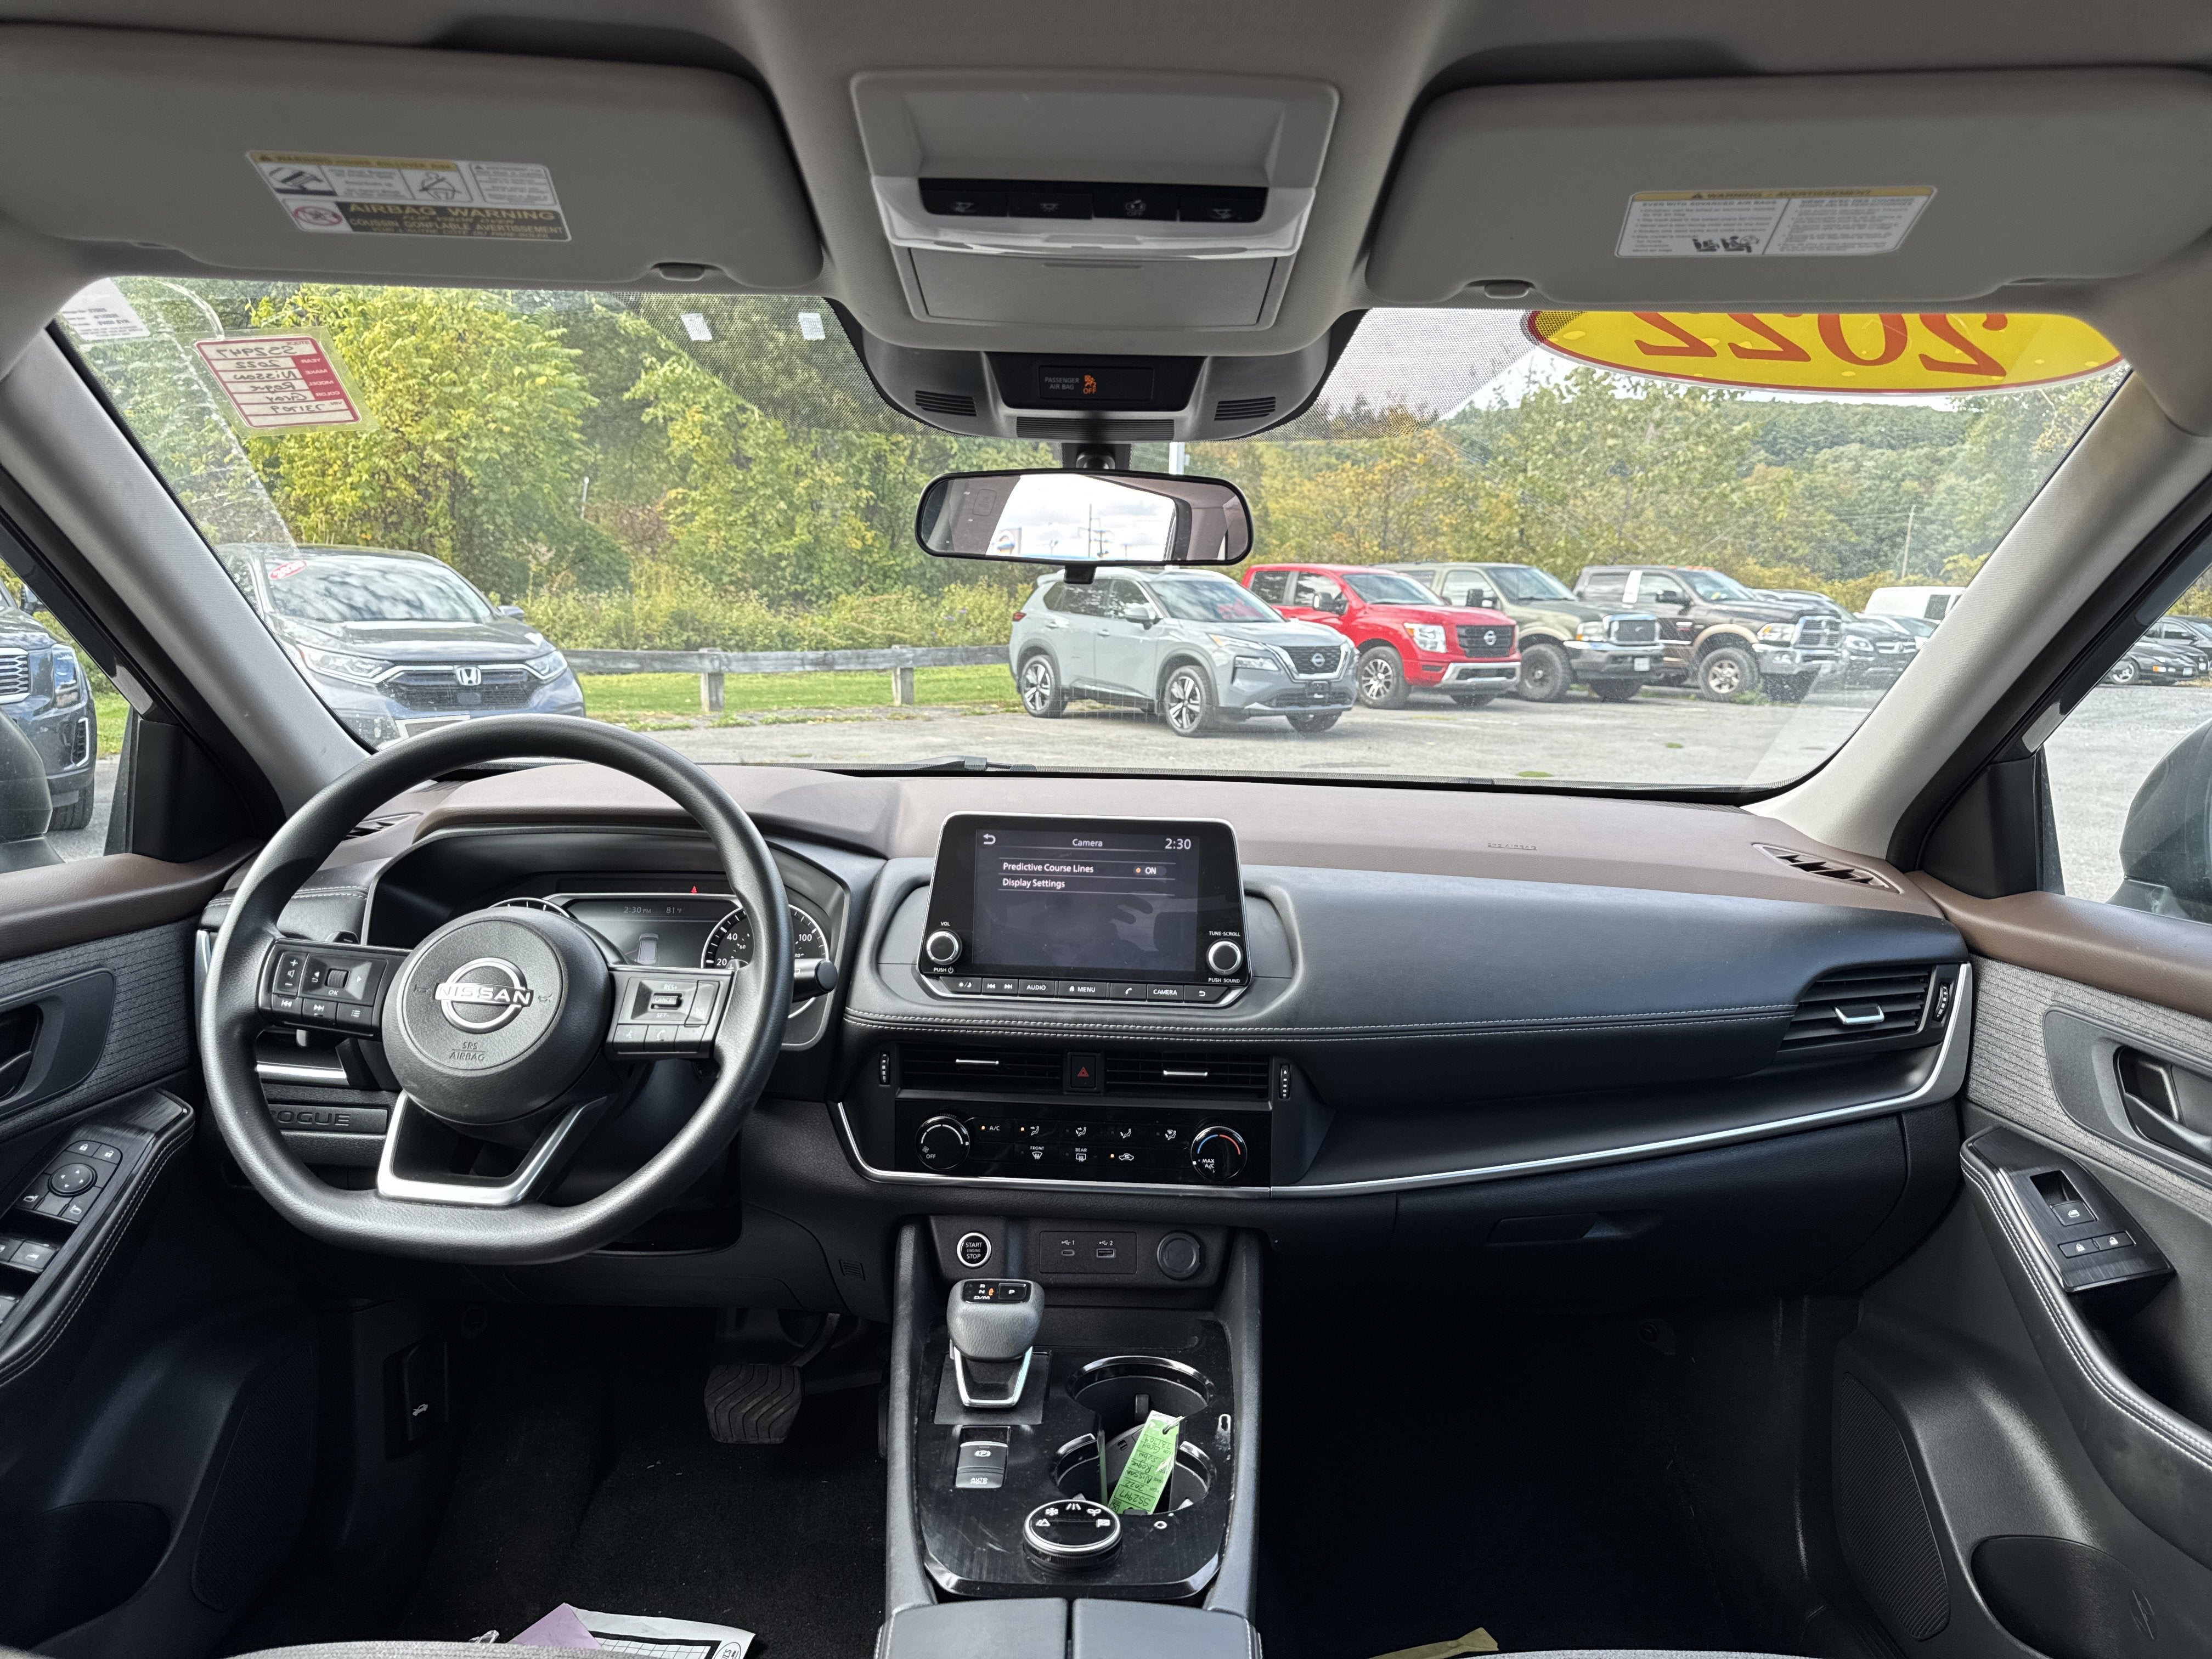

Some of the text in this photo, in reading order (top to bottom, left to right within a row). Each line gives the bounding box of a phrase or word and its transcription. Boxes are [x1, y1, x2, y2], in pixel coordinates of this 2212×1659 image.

[349, 203, 555, 220] AIRBAG WARNING
[476, 224, 563, 234] AVERTISSEMENT
[1072, 838, 1103, 848] Camera
[1165, 838, 1192, 850] 2:30
[1003, 862, 1094, 873] Predictive Course Lines
[1145, 867, 1156, 875] ON
[1002, 878, 1065, 889] Display Settings
[438, 984, 531, 1005] NISSAN
[449, 1052, 486, 1061] AIRBAG
[1142, 1443, 1161, 1453] Gray
[1125, 1481, 1144, 1492] 2022
[1119, 1489, 1152, 1506] SS2947
